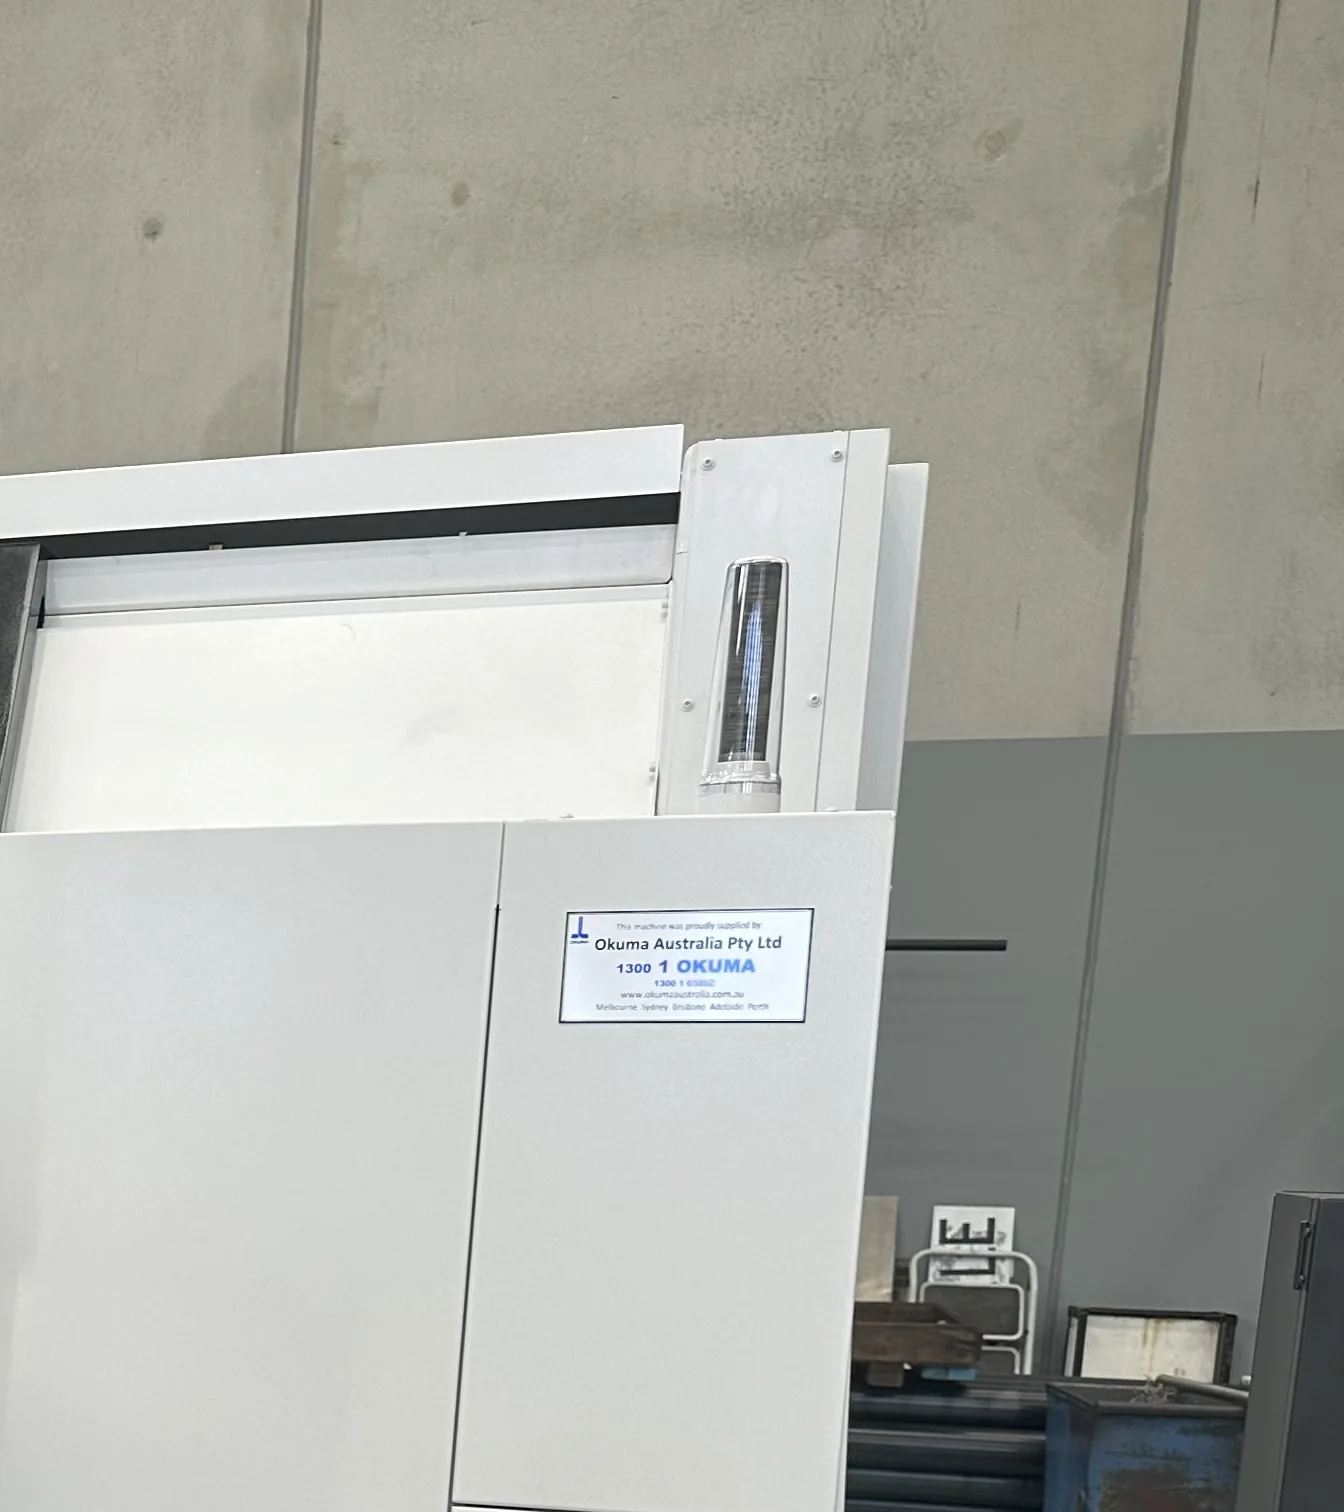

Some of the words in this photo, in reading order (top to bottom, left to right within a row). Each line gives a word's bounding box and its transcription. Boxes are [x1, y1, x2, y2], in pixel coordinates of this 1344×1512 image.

[595, 938, 649, 951] Okuma
[654, 936, 723, 950] Australia
[728, 937, 753, 952] Pty
[758, 936, 782, 949] Ltd
[617, 963, 651, 974] 1300
[659, 960, 668, 974] 1
[677, 959, 756, 973] OKUMA
